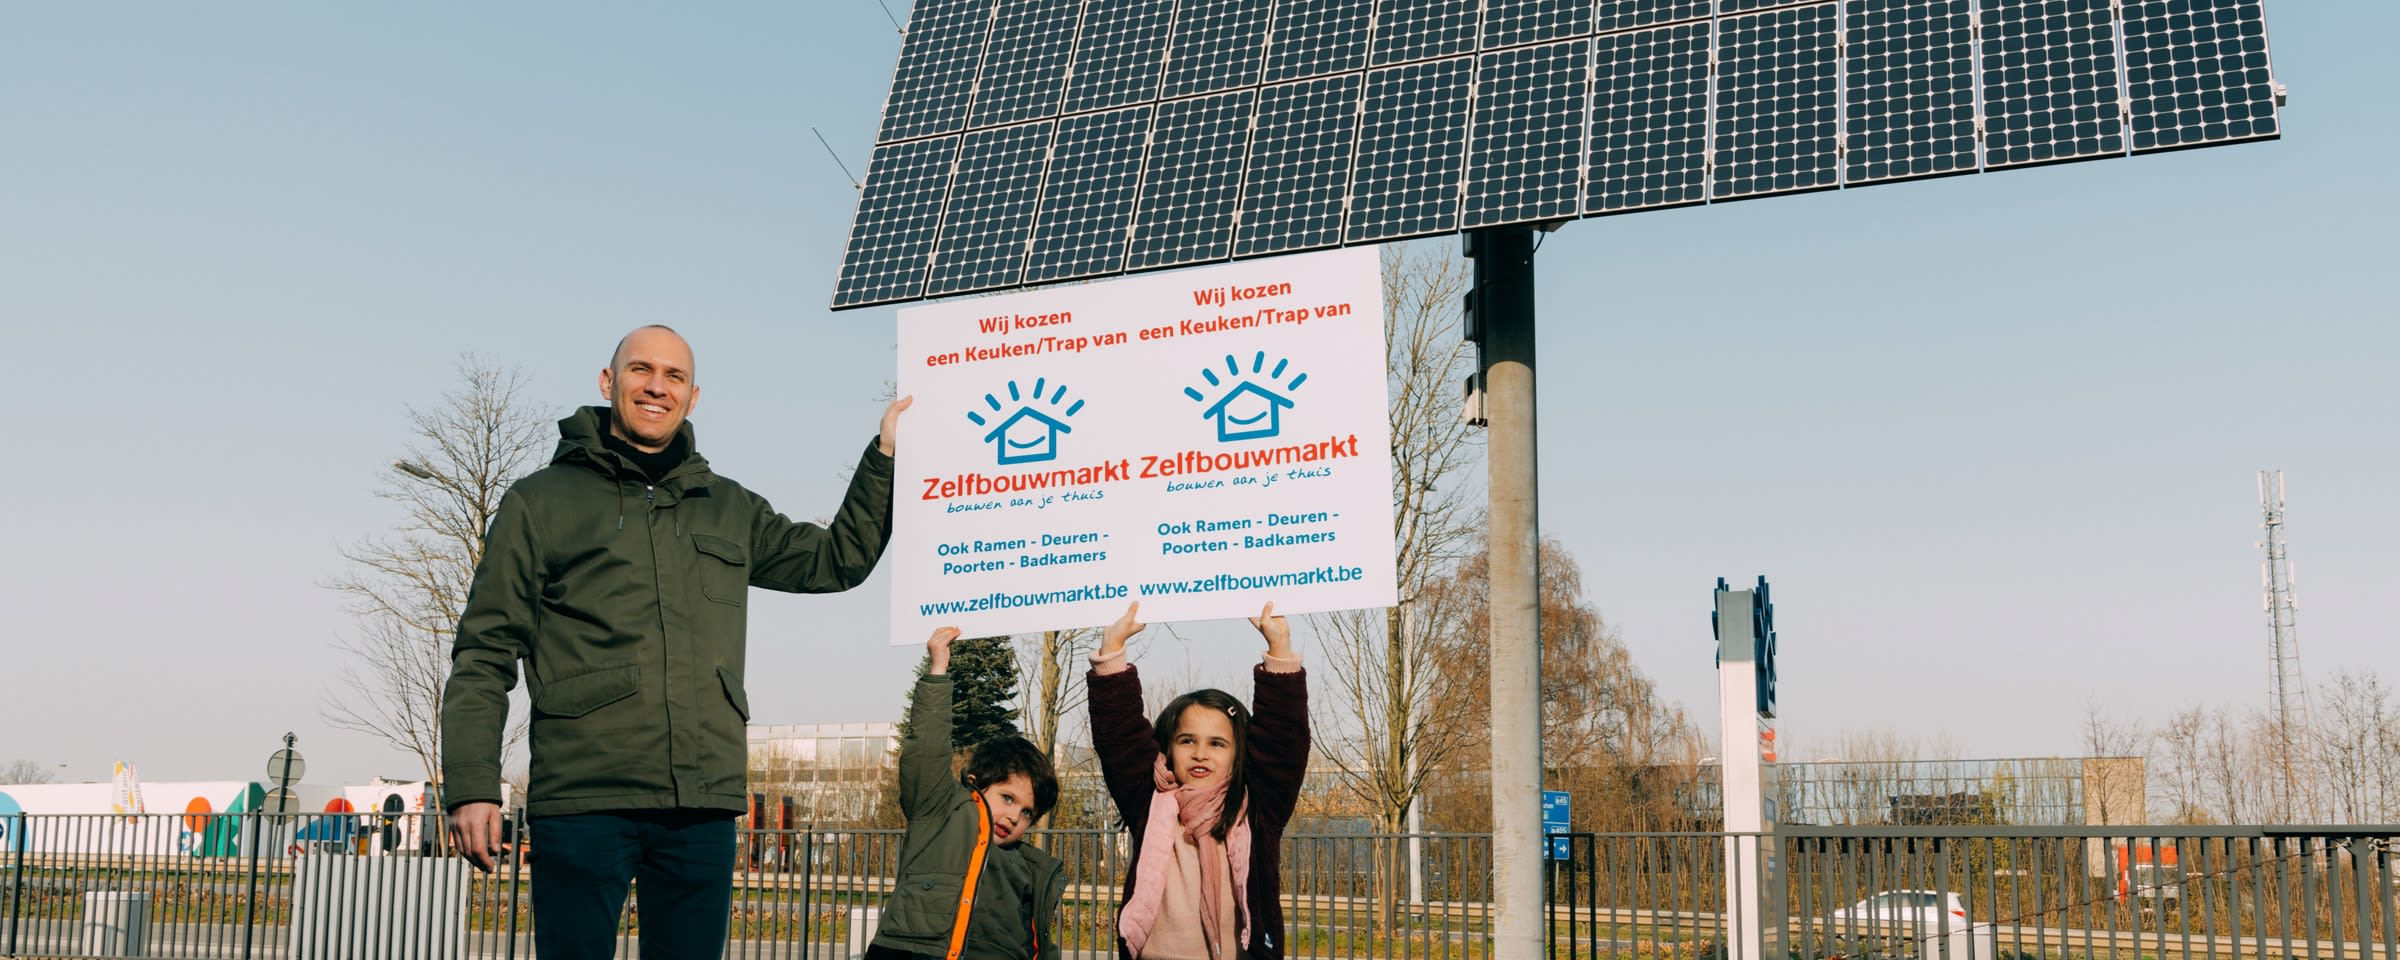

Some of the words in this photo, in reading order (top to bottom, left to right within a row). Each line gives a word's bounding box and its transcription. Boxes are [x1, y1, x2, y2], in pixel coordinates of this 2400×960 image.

[1194, 288, 1225, 308] Wij
[1231, 283, 1292, 301] kozen
[979, 316, 1009, 335] Wij
[1014, 312, 1072, 329] kozen
[1139, 325, 1174, 341] een
[1180, 308, 1309, 336] Keuken/Trap
[1314, 304, 1351, 318] van
[927, 353, 959, 367] een
[965, 336, 1088, 362] Keuken/Trap
[1093, 332, 1127, 347] van
[1139, 434, 1358, 479] Zelfbouwmarkt
[922, 458, 1130, 501] Zelfbouwmarkt
[1167, 479, 1225, 492] bouwen
[1233, 475, 1259, 485] aan
[1263, 471, 1279, 487] je
[1286, 466, 1331, 480] thuis
[947, 502, 1001, 513] bouwen
[1010, 496, 1033, 507] aan
[1039, 494, 1054, 509] je
[1061, 489, 1104, 501] thuis
[1157, 522, 1190, 536] Ook
[1196, 519, 1252, 533] Ramen
[1268, 512, 1327, 526] Deuren
[937, 543, 968, 557] Ook
[973, 539, 1026, 552] Ramen
[1041, 532, 1098, 548] Deuren
[1162, 541, 1228, 555] Poorten
[1244, 532, 1335, 549] Badkamers
[944, 560, 1004, 575] Poorten
[1020, 551, 1106, 569] Badkamers
[1139, 565, 1362, 595] www.zelfbouwmarkt.be
[920, 583, 1128, 616] www.zelfbouwmarkt.be
